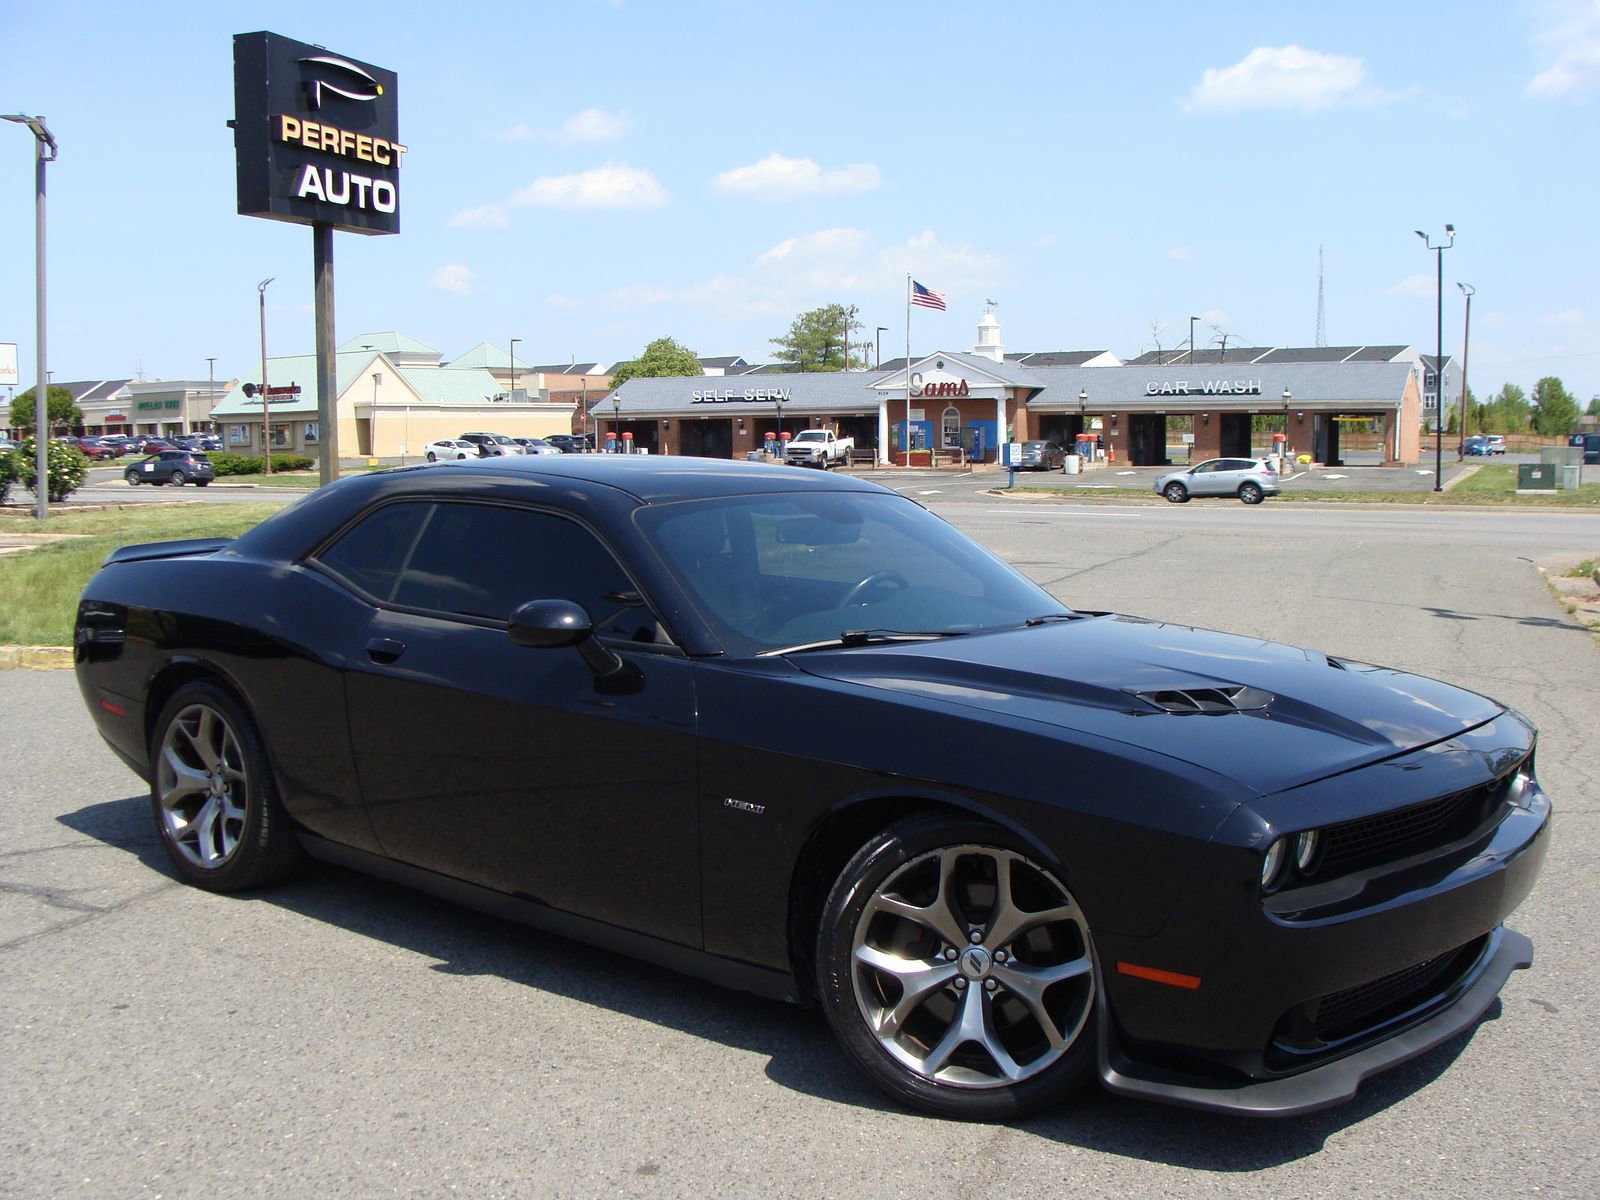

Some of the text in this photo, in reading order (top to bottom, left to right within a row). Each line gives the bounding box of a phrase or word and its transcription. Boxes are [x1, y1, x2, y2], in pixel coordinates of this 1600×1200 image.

[281, 115, 408, 169] PERFECT
[298, 164, 396, 214] AUTO
[692, 389, 735, 402] SELF
[909, 372, 971, 397] Sams
[1146, 379, 1262, 395] CAR WASH
